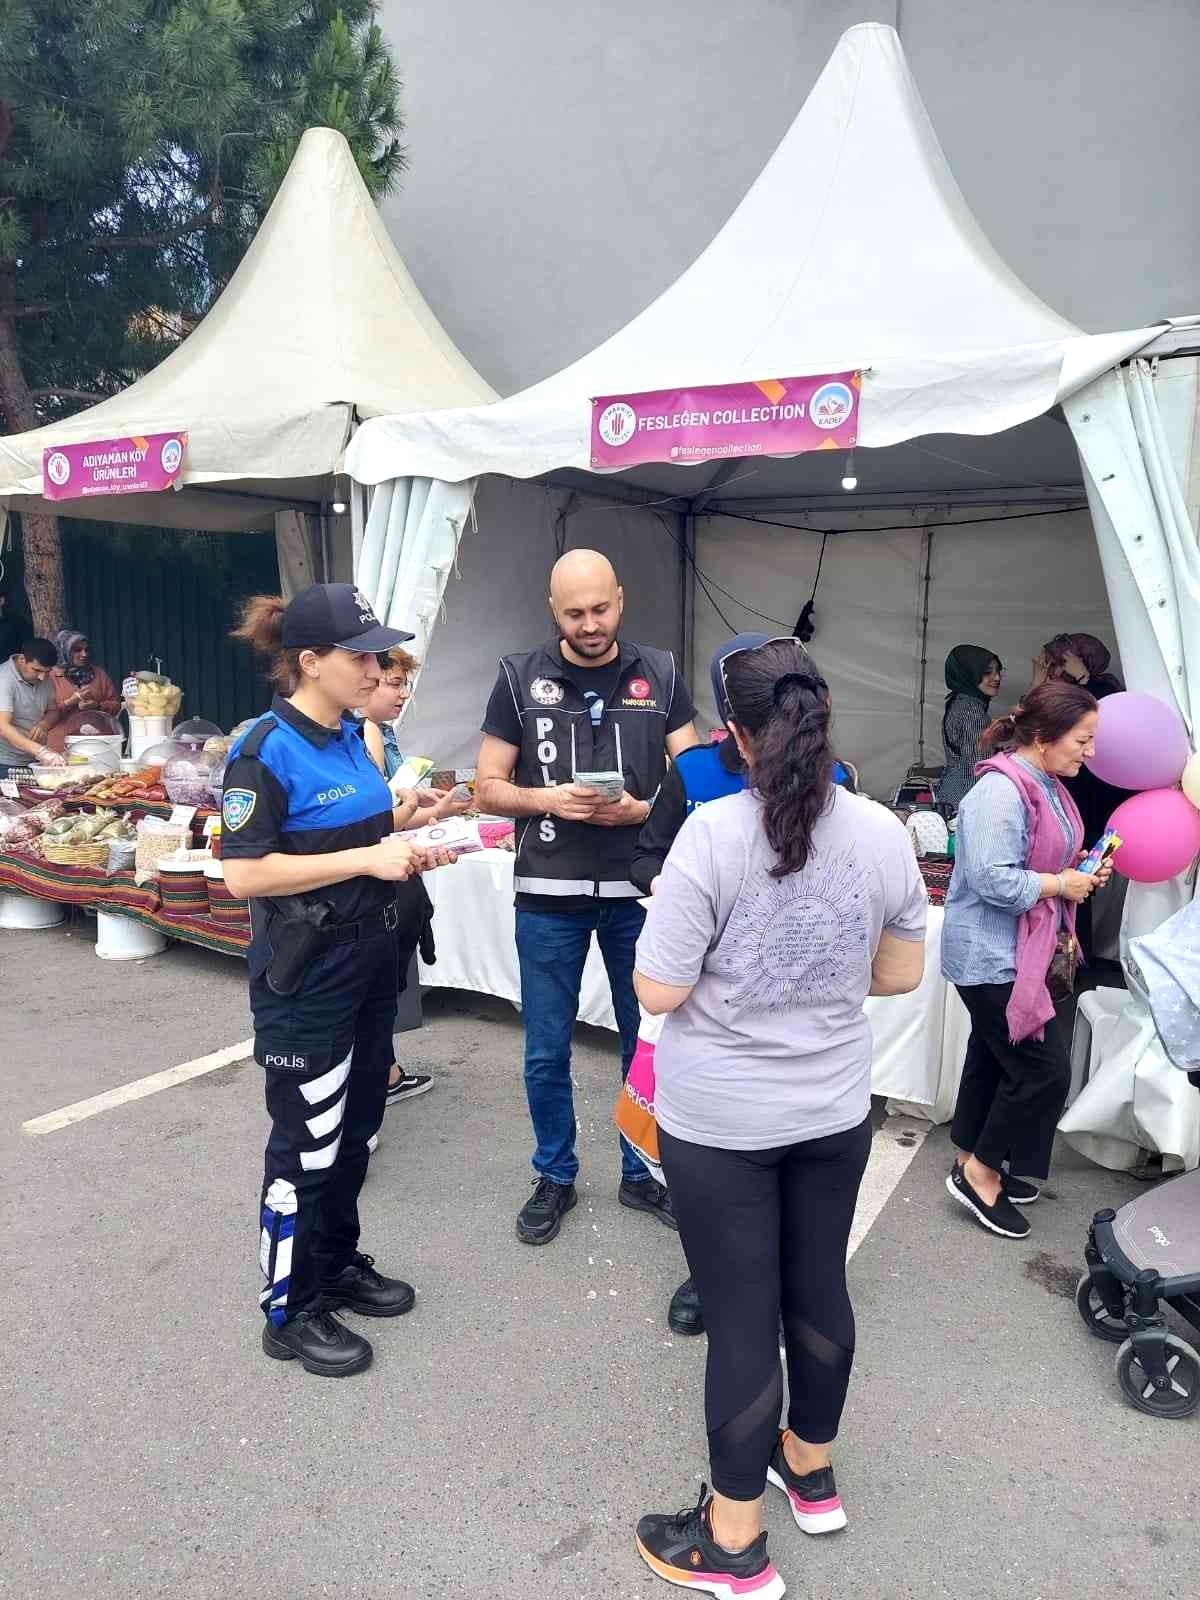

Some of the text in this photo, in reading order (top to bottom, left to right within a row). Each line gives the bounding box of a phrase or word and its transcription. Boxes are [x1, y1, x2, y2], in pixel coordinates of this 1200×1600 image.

[713, 404, 805, 425] COLLECTION
[82, 448, 147, 468] ADIYAMAN KÖY
[93, 464, 137, 481] ÜRÜNLERİ
[536, 717, 557, 842] POLS
